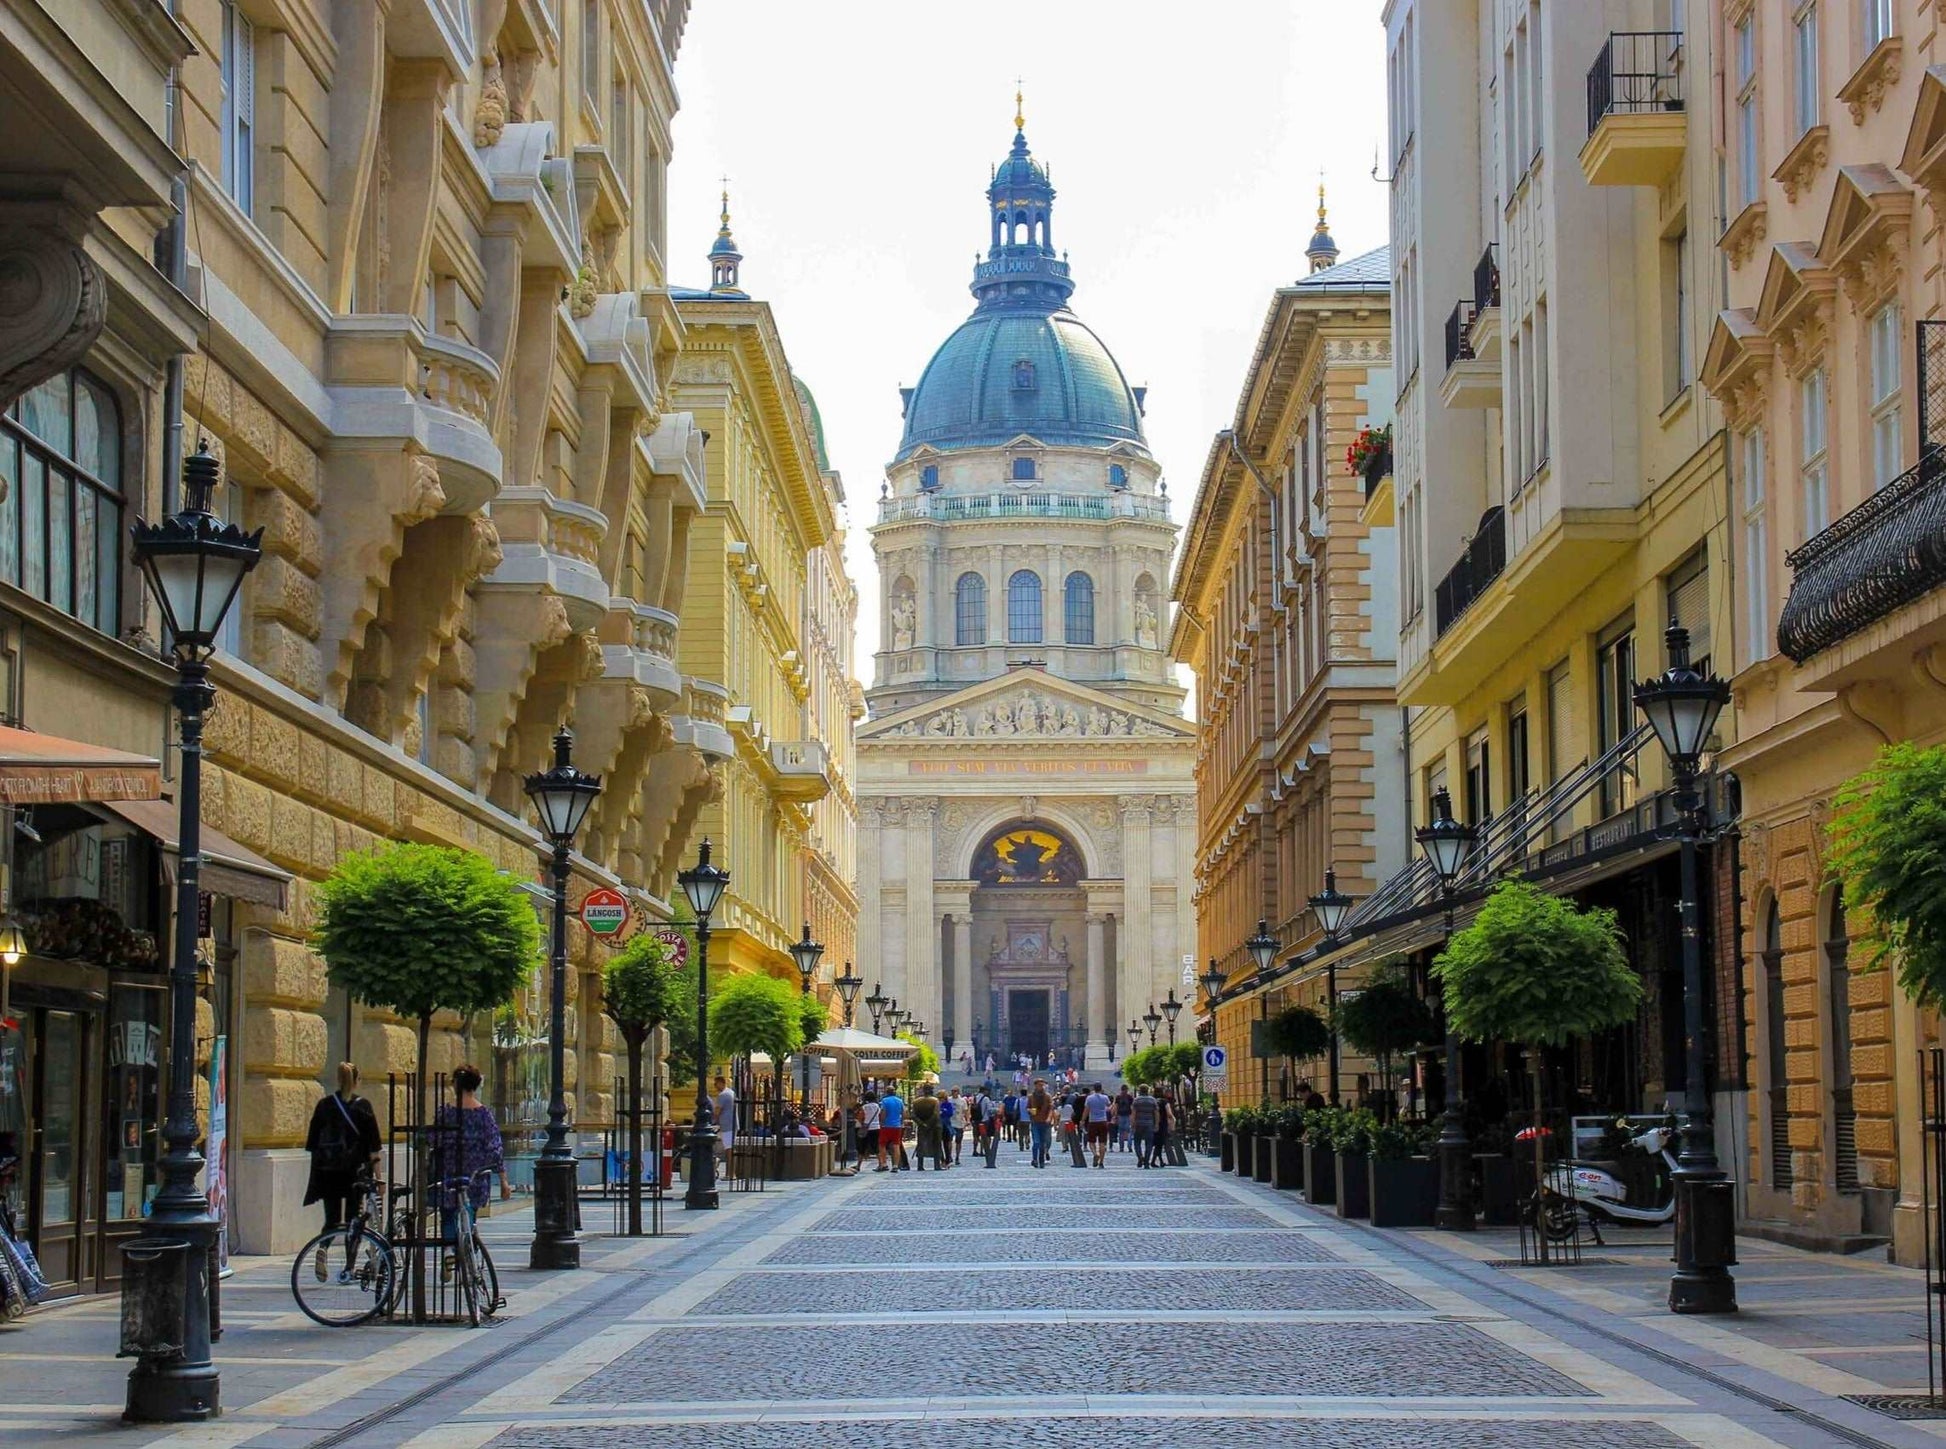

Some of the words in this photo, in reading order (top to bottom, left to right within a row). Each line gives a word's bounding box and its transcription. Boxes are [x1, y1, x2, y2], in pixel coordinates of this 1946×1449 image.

[1183, 955, 1194, 985] BAR
[803, 1046, 830, 1057] COFFEE
[853, 1050, 879, 1059] COSTA
[881, 1050, 909, 1059] COFFEE
